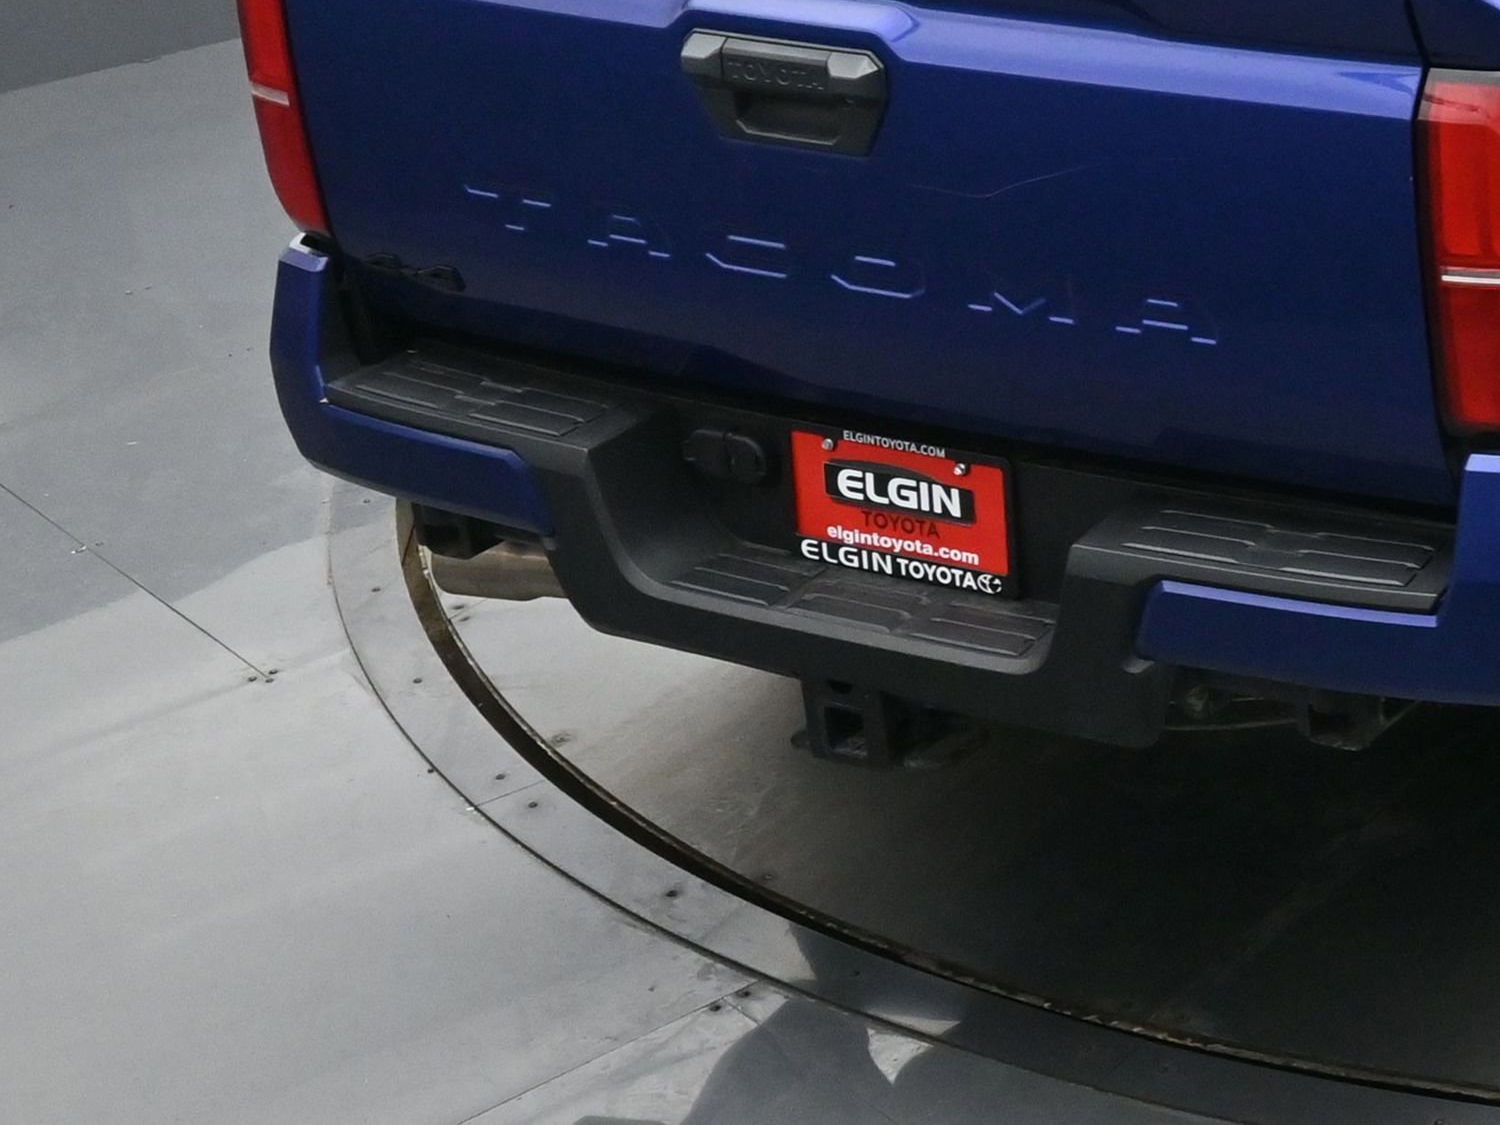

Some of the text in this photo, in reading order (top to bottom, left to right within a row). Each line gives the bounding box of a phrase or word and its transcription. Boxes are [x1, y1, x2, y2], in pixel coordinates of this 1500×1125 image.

[727, 60, 825, 91] TOYOTA
[463, 183, 1218, 345] TACOMA
[843, 430, 946, 459] ELGINTOYOTA.COM
[837, 468, 962, 518] ELGIN
[827, 525, 979, 565] elgintoyota.com
[862, 510, 941, 540] TOYOTA
[801, 539, 978, 590] ELGIN TOYOTA
